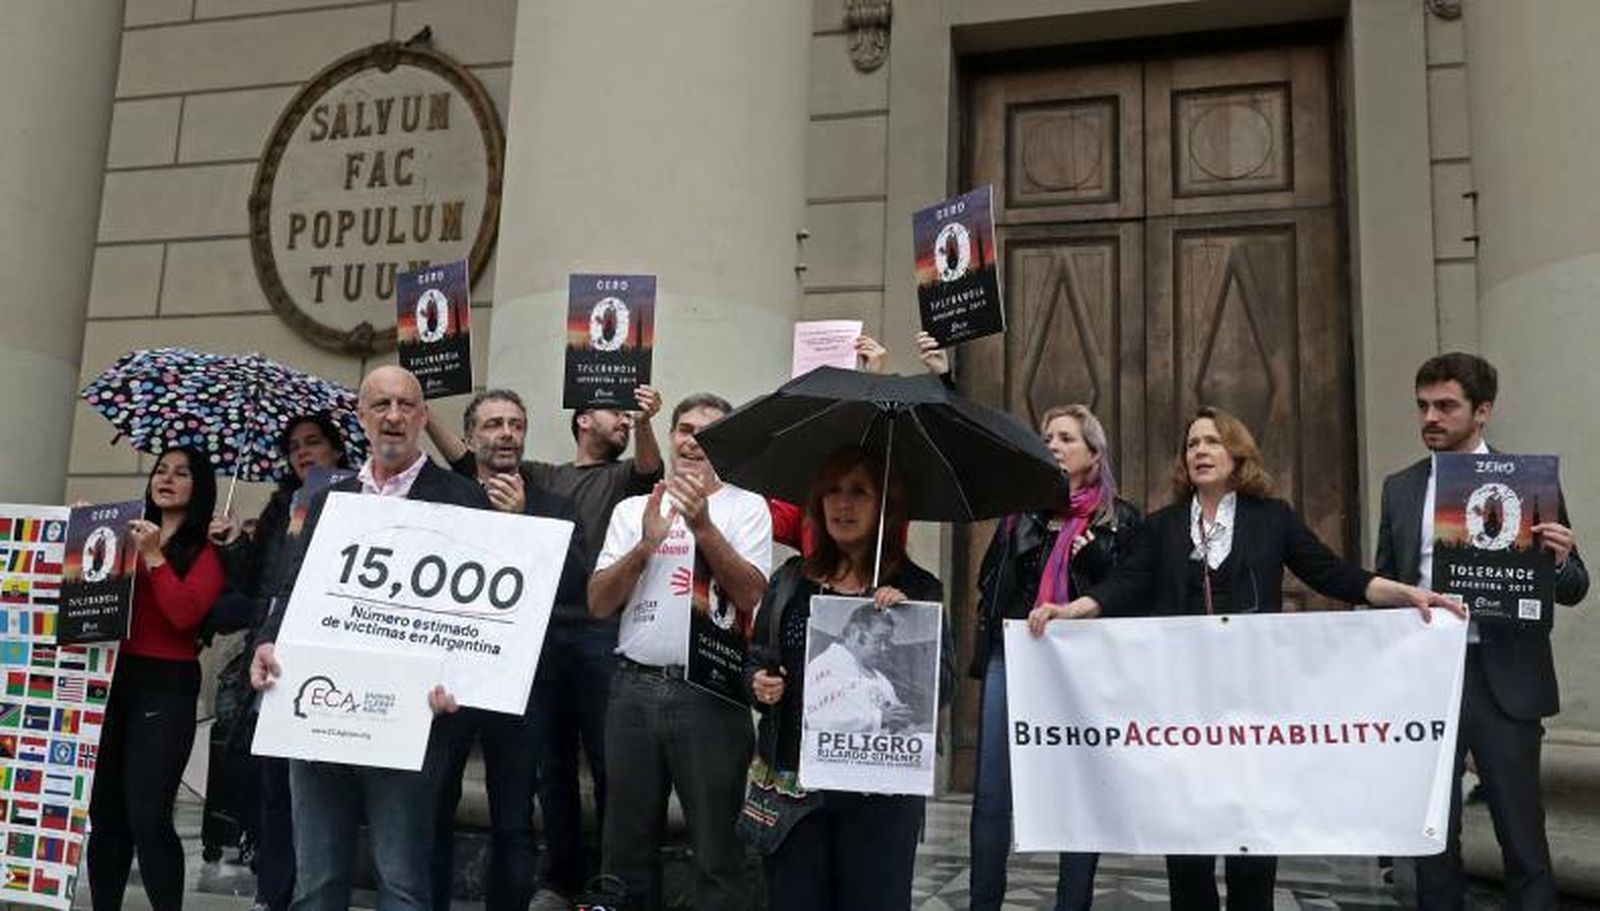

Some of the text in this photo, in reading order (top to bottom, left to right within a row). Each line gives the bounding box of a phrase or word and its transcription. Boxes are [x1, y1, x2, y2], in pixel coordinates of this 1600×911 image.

[309, 92, 451, 142] SALVUM
[344, 148, 414, 190] FAC
[287, 202, 466, 250] POPULUM
[310, 260, 430, 303] TUU
[1475, 461, 1515, 474] ZERO
[340, 544, 524, 610] 15,000
[1449, 564, 1534, 580] TOLERANCE
[321, 615, 339, 629] de
[409, 631, 428, 644] en
[429, 633, 501, 655] Argentina
[413, 614, 479, 638] estimado
[818, 732, 923, 754] PELIGRO
[818, 749, 868, 761] RICARDO
